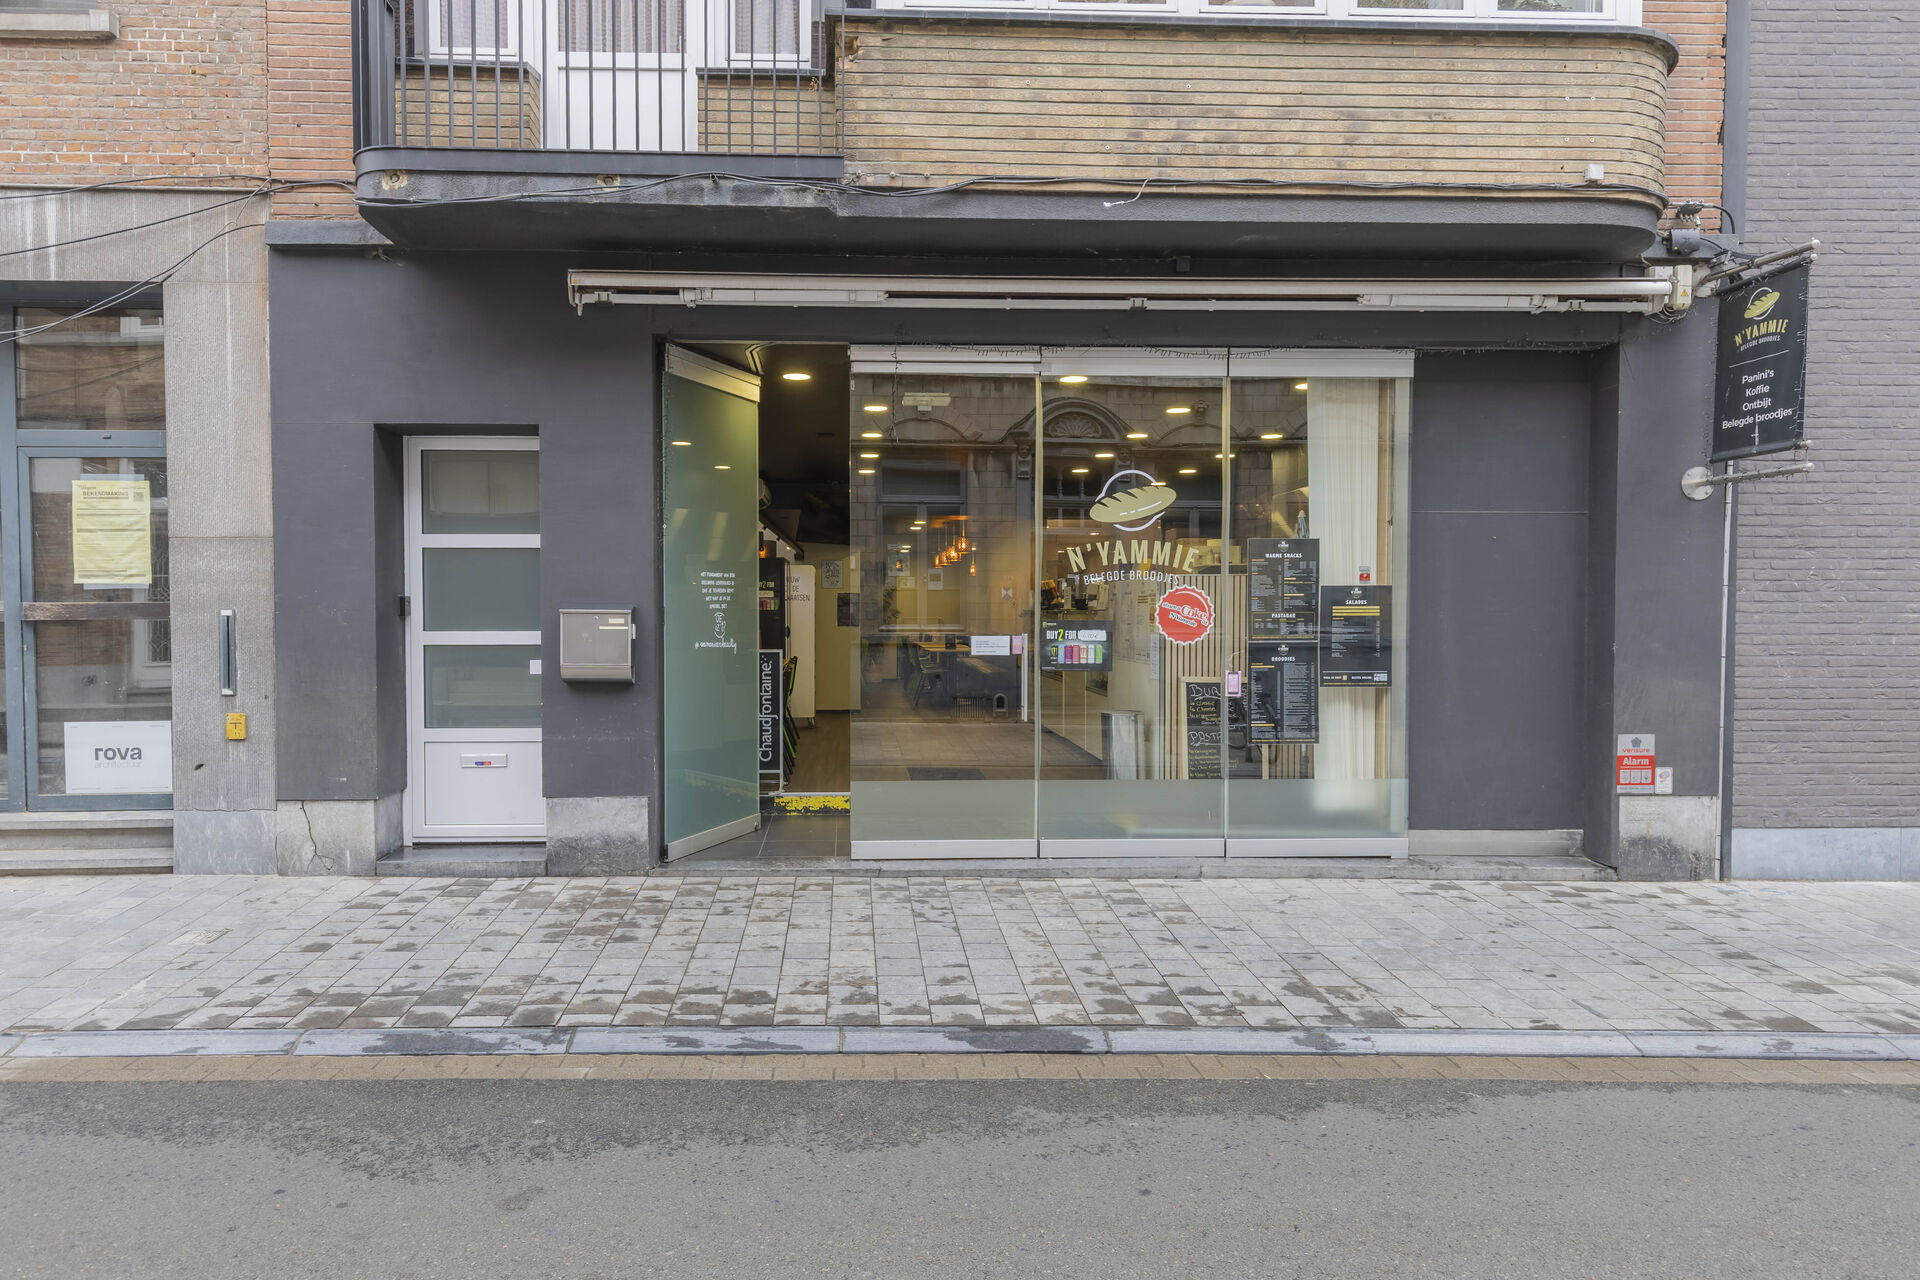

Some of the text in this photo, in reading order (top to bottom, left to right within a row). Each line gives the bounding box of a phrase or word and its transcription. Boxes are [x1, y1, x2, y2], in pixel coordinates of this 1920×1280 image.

[1735, 319, 1789, 347] N'YAMMIE
[1742, 369, 1775, 385] Panini's
[1745, 384, 1770, 397] Koffie
[1742, 397, 1772, 411] Ontbijt
[1722, 408, 1793, 429] Belegde broodjes
[1067, 539, 1200, 573] N'YAMMIE
[1083, 570, 1180, 585] BELEGDE BROODJES
[1046, 630, 1058, 640] BUY
[1065, 630, 1077, 640] FOR
[760, 660, 779, 762] Chaudfontaine
[94, 746, 142, 761] rova
[1622, 757, 1649, 766] Alarm
